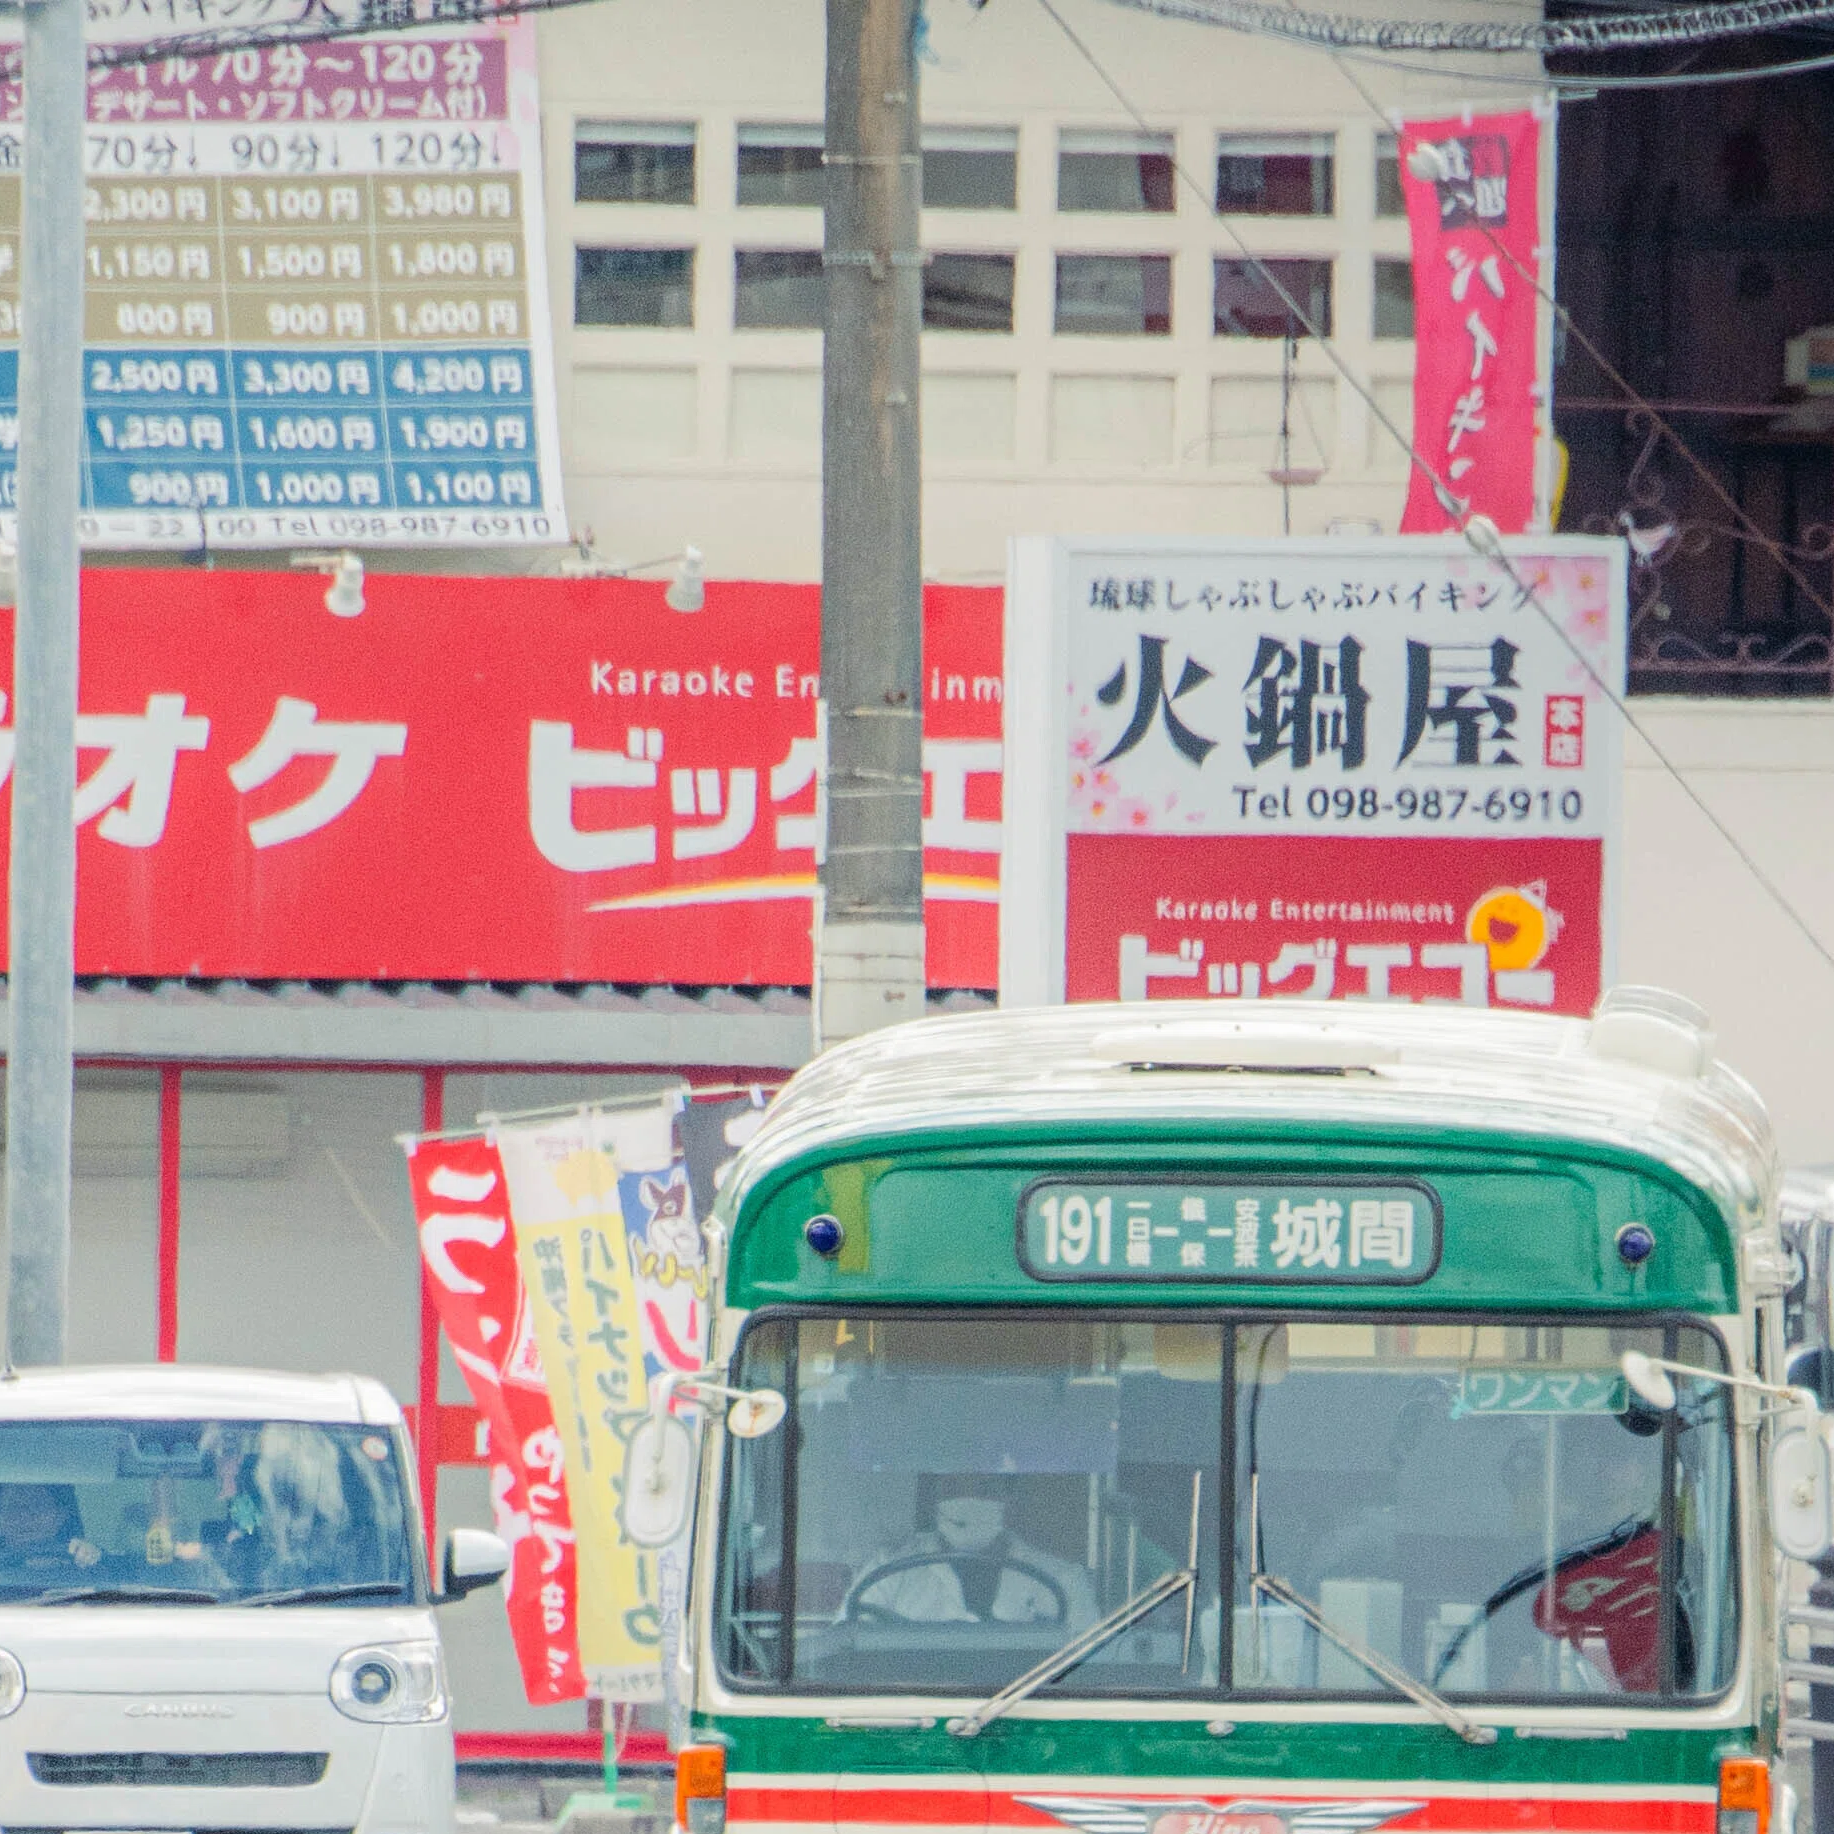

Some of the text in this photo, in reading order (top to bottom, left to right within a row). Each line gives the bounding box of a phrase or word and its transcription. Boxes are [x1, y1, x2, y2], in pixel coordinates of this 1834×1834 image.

[231, 133, 320, 171] 90分
[373, 131, 483, 171] 120分
[91, 359, 218, 395] 2,500円
[244, 358, 371, 396] 3,300円
[97, 415, 225, 451] 1,250円
[256, 470, 381, 505] 1,000円
[406, 470, 533, 505] 1,100円
[590, 660, 755, 698] Karaoke
[1092, 633, 1523, 771] 火鍋屋
[1231, 785, 1583, 823] Tel 098-987-6910
[1156, 897, 1455, 926] Karaoke Entertainment
[1040, 1195, 1112, 1266] 191
[1270, 1197, 1414, 1269] 城間
